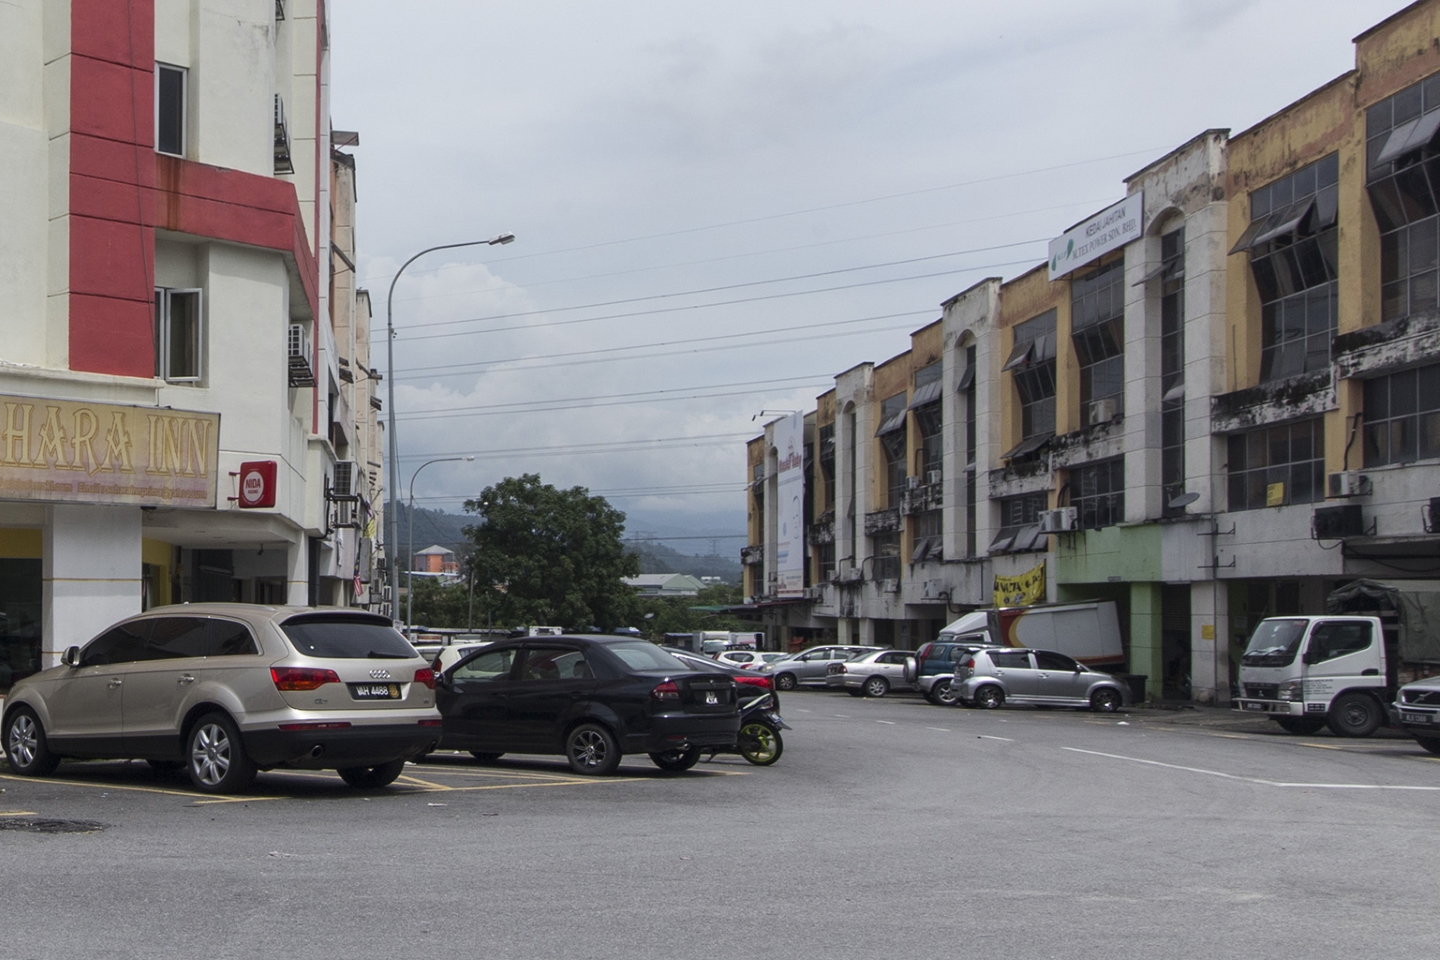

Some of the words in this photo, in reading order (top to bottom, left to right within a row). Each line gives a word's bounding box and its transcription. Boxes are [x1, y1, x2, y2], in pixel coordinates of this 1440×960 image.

[1085, 220, 1102, 238] KEDAI
[1102, 206, 1126, 229] JAHITAN
[1089, 233, 1107, 252] POWER
[146, 414, 213, 479] INN
[245, 478, 261, 489] NIDA
